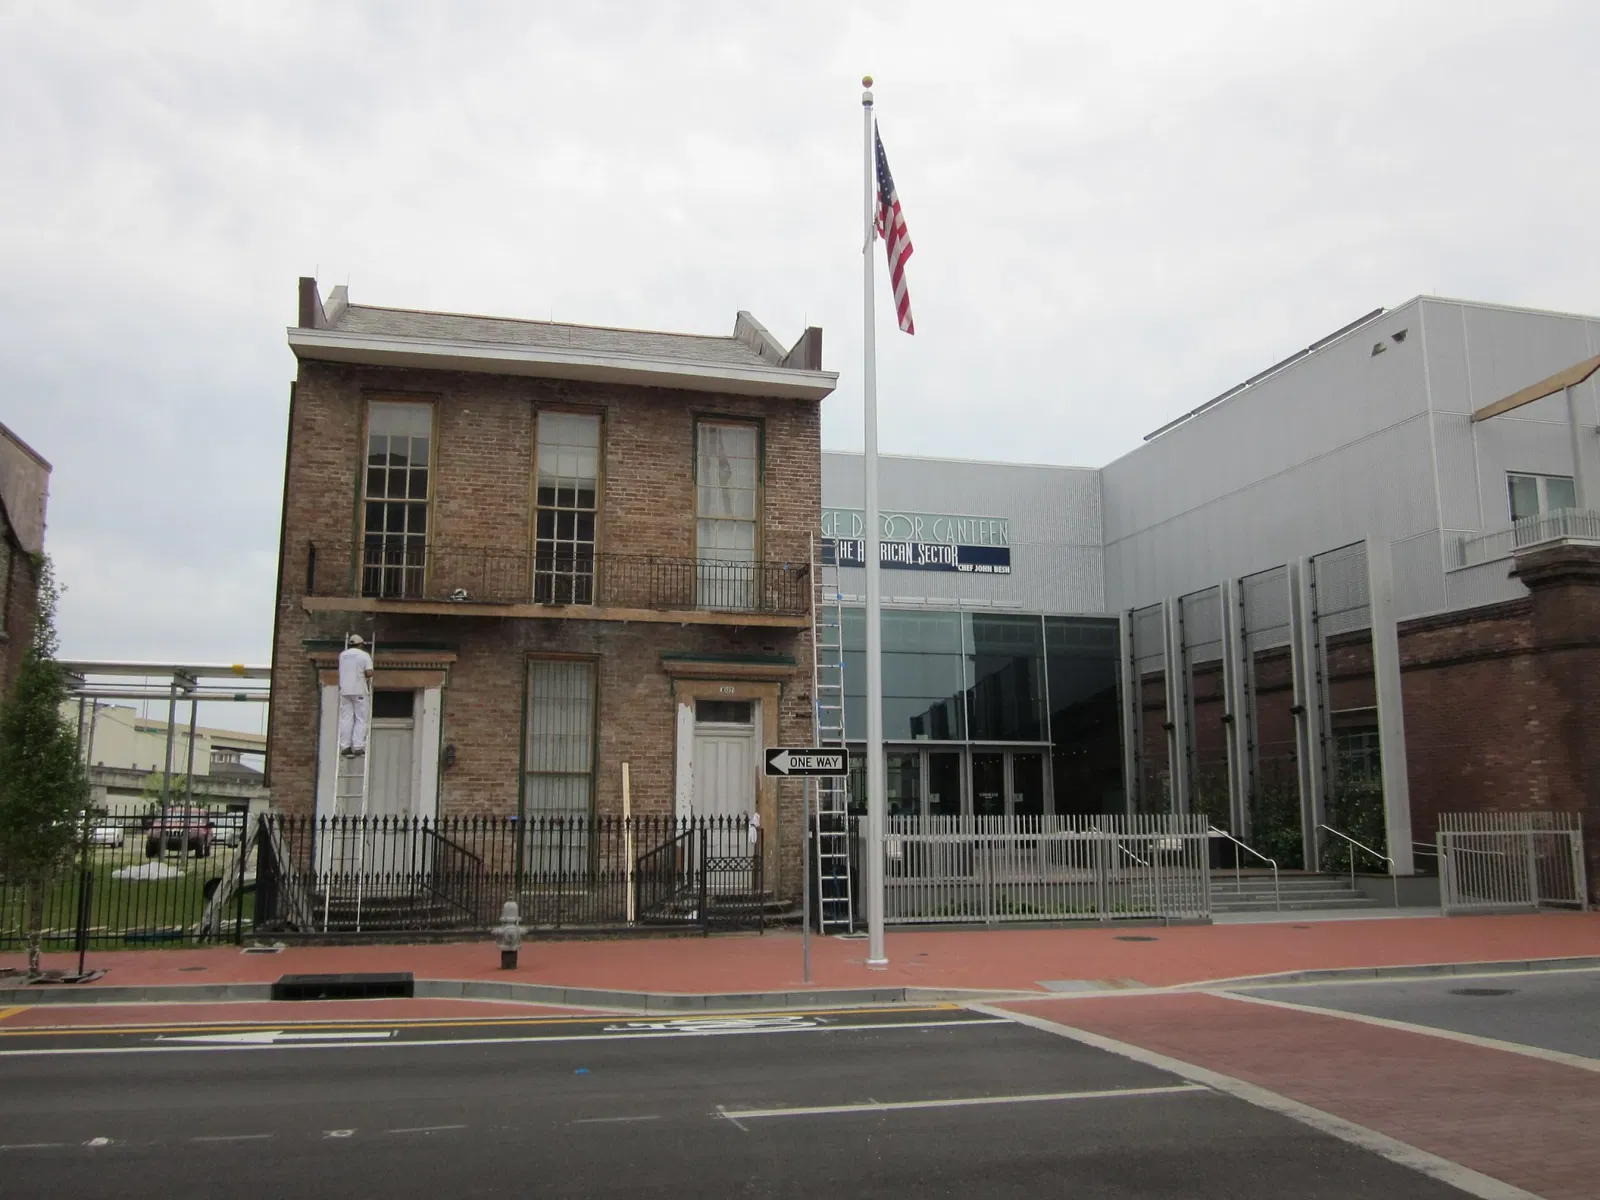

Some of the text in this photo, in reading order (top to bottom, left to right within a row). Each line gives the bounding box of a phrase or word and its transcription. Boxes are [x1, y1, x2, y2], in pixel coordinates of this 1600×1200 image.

[821, 512, 840, 537] GE
[933, 518, 1008, 546] CANTEEN
[833, 540, 958, 567] HE ARICAN SECTOR
[958, 564, 1010, 574] CHEF JOHN BESH
[790, 757, 839, 768] ONE WAY
